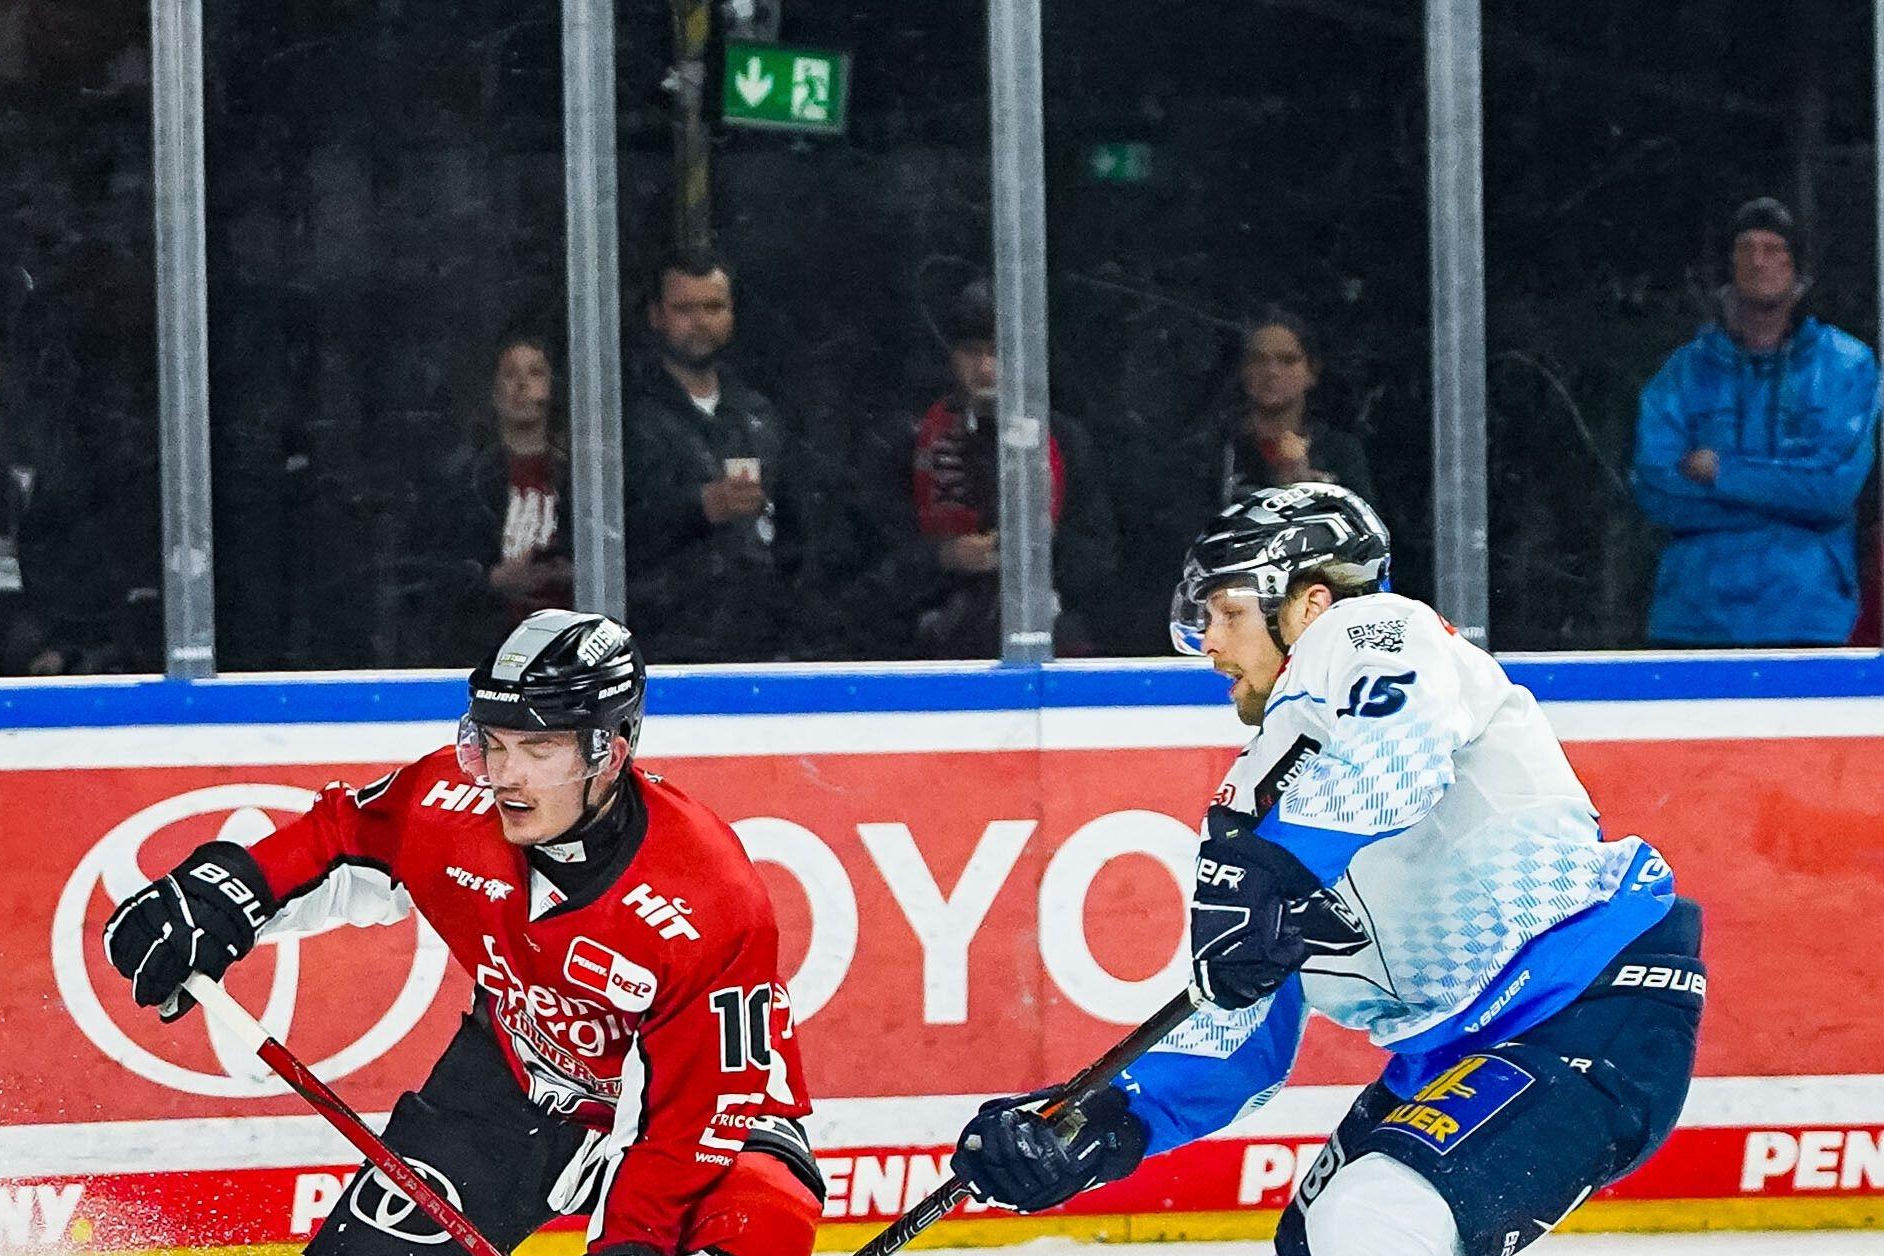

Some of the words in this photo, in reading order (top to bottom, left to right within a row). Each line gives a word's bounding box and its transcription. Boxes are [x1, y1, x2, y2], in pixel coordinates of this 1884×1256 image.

[1336, 670, 1417, 718] 15
[621, 883, 701, 941] HIT
[727, 809, 1204, 1025] OYO
[709, 982, 772, 1072] 10
[711, 1113, 756, 1129] TRICO
[817, 1153, 988, 1217] ENN
